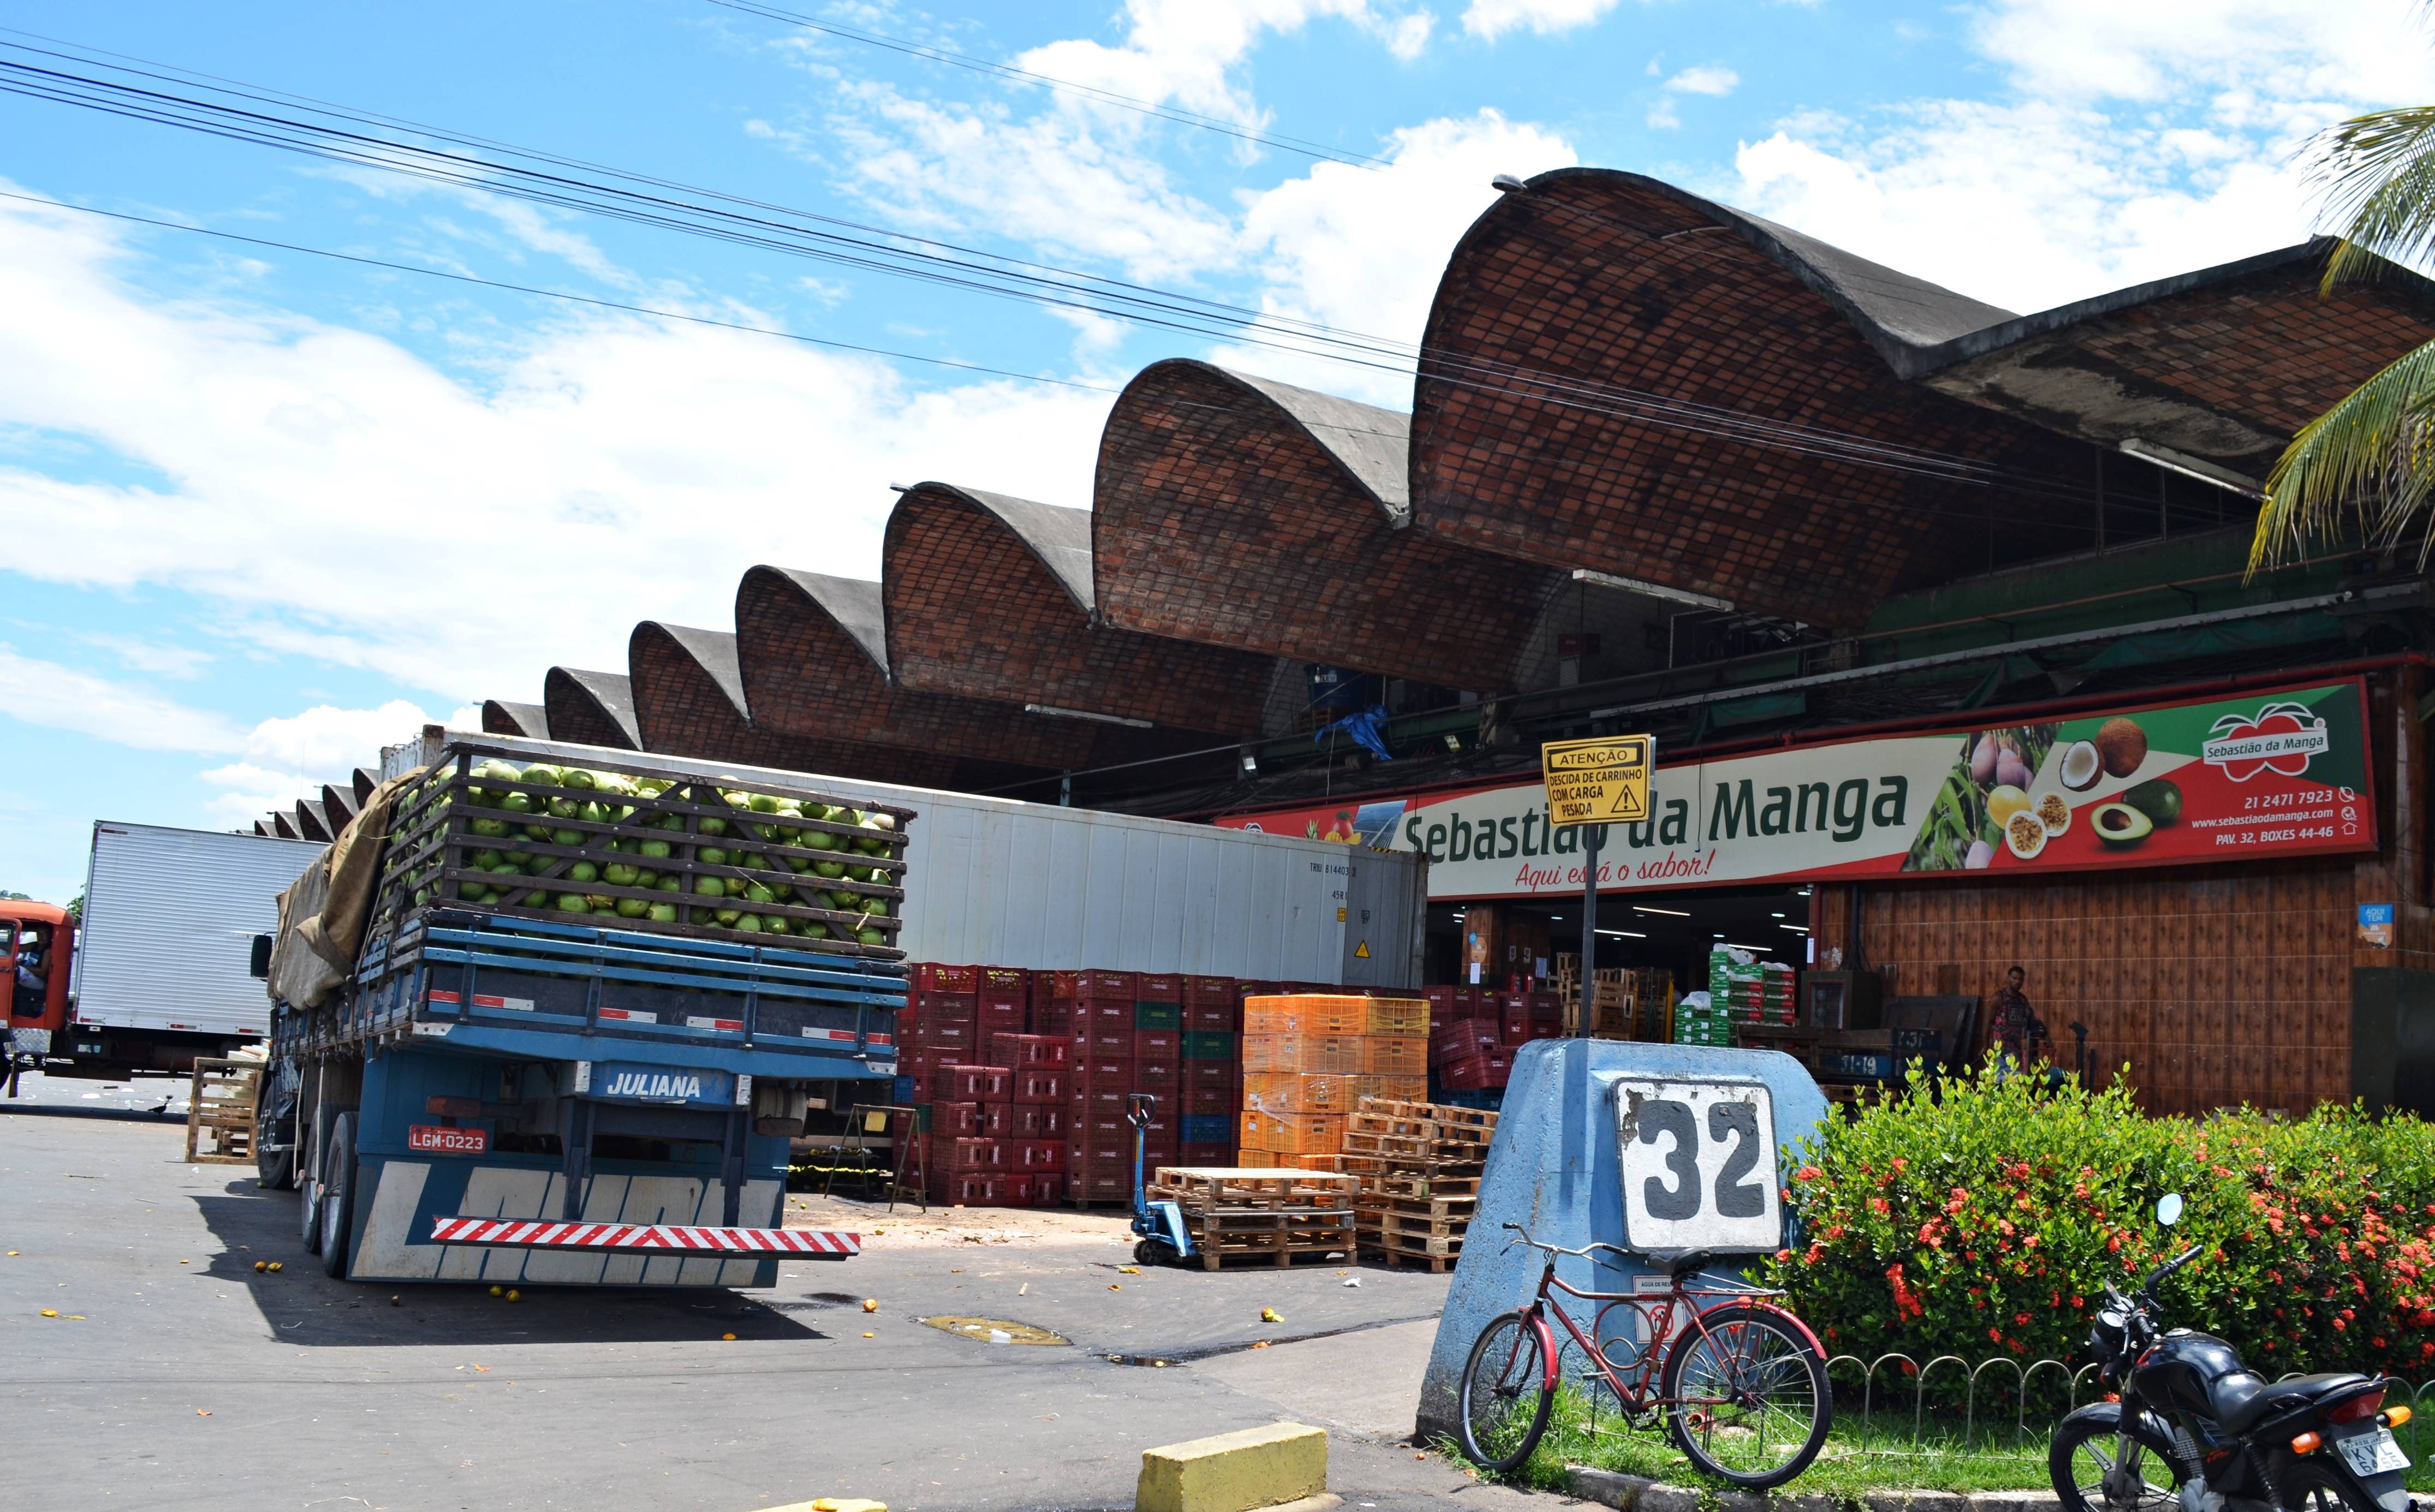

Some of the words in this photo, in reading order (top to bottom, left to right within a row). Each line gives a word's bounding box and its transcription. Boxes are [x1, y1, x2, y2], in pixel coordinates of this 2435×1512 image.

[2207, 742, 2261, 758] Sebastião
[2266, 740, 2279, 751] da
[2283, 736, 2324, 750] Manga
[1560, 749, 1628, 765] ATENÇÃO
[1550, 773, 1580, 786] DESCIDA
[1582, 772, 1594, 783] DE
[1596, 769, 1642, 782] CARRINHO
[1552, 789, 1568, 802] COM
[1569, 785, 1604, 800] CARGA
[2245, 797, 2258, 809] 21
[2263, 794, 2293, 807] 2471
[2299, 789, 2333, 805] 7923
[1561, 802, 1592, 817] PESADA
[1708, 775, 1908, 842] Manga
[2192, 809, 2333, 828] www.sebastiaodamanga.com
[2216, 834, 2236, 845] PAV.
[2240, 832, 2256, 844] 32,
[2260, 829, 2295, 842] BOXES
[2299, 826, 2333, 839] 44-46
[1310, 863, 1322, 873] TRIU
[1325, 865, 1349, 876] 814403
[1515, 862, 1561, 892] Aqui
[1568, 861, 1611, 883] esá
[1617, 865, 1630, 880] o
[1636, 848, 1716, 879] sabor!
[1332, 890, 1347, 900] 45R1
[607, 1072, 700, 1098] JULIANA
[413, 1133, 484, 1150] LGM-0223
[1638, 1099, 1765, 1220] 32
[2351, 1443, 2393, 1461] KVL
